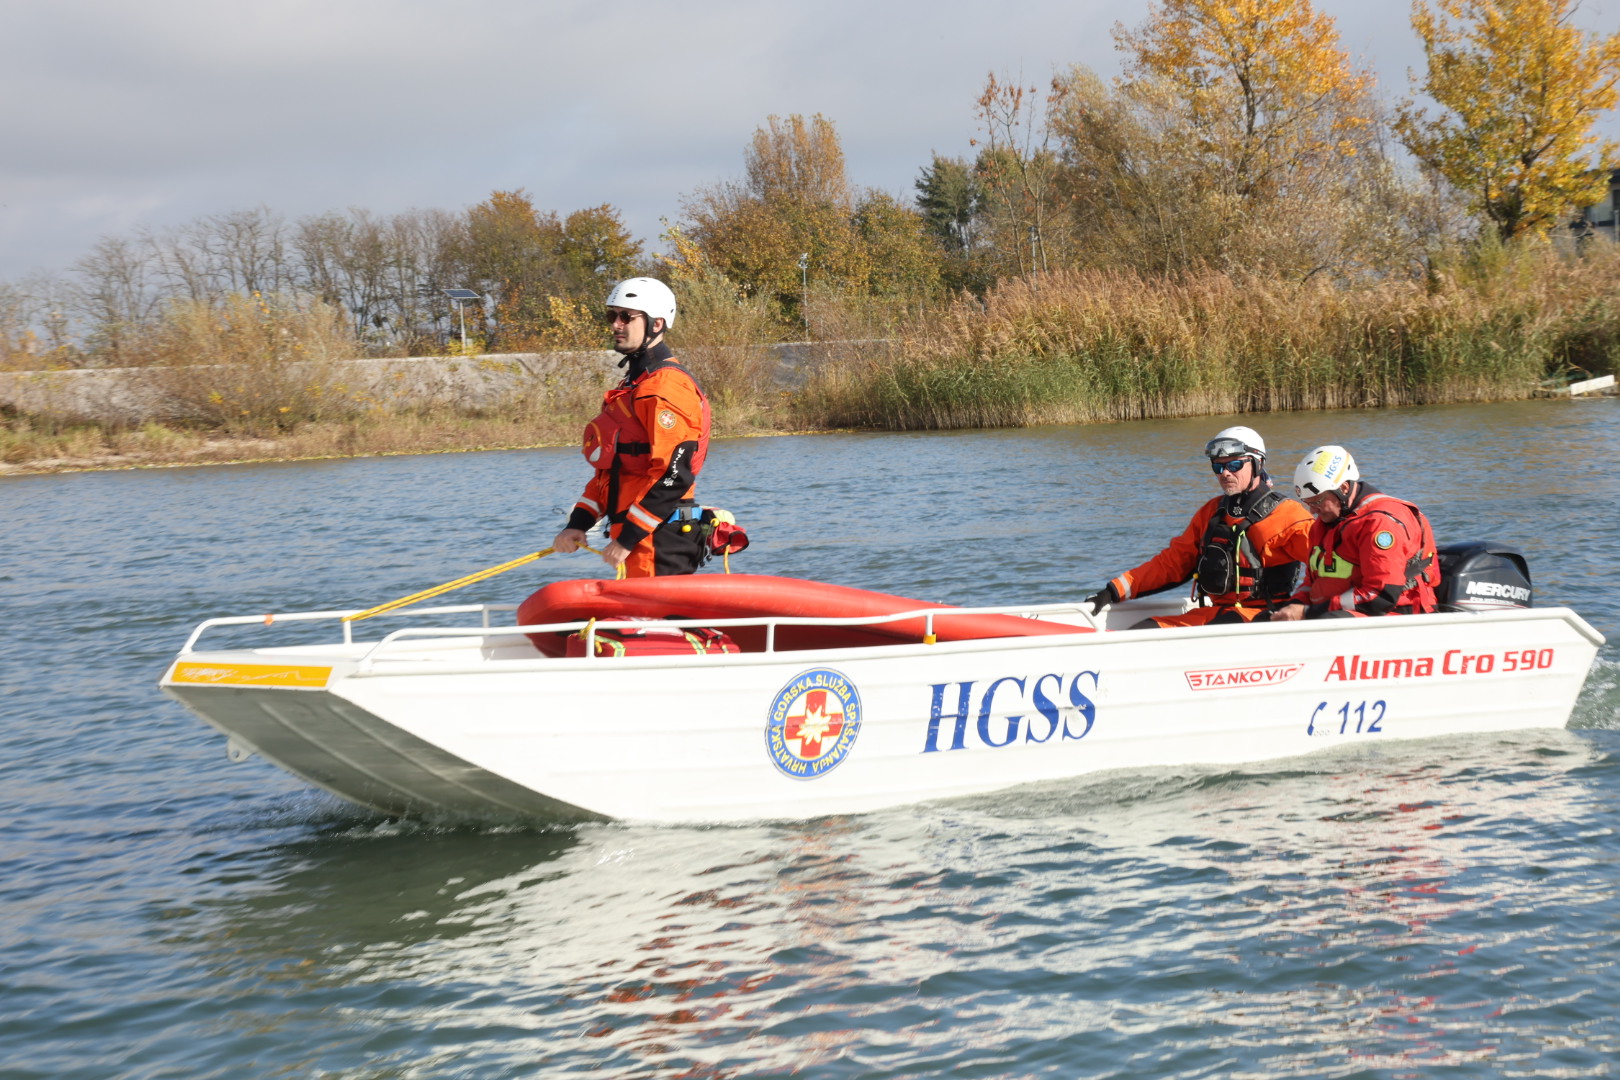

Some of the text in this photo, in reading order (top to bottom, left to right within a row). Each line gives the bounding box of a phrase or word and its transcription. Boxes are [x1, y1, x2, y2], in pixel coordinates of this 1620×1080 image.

[1324, 455, 1342, 479] HGSS
[1465, 581, 1531, 601] MERCURY
[1323, 647, 1555, 682] Aluma Cro 590
[773, 676, 815, 722] GORSKA
[815, 674, 852, 704] SLUŽBA
[919, 670, 1100, 754] HGSS
[1337, 699, 1387, 734] 112
[771, 725, 808, 775] HRVATSKA
